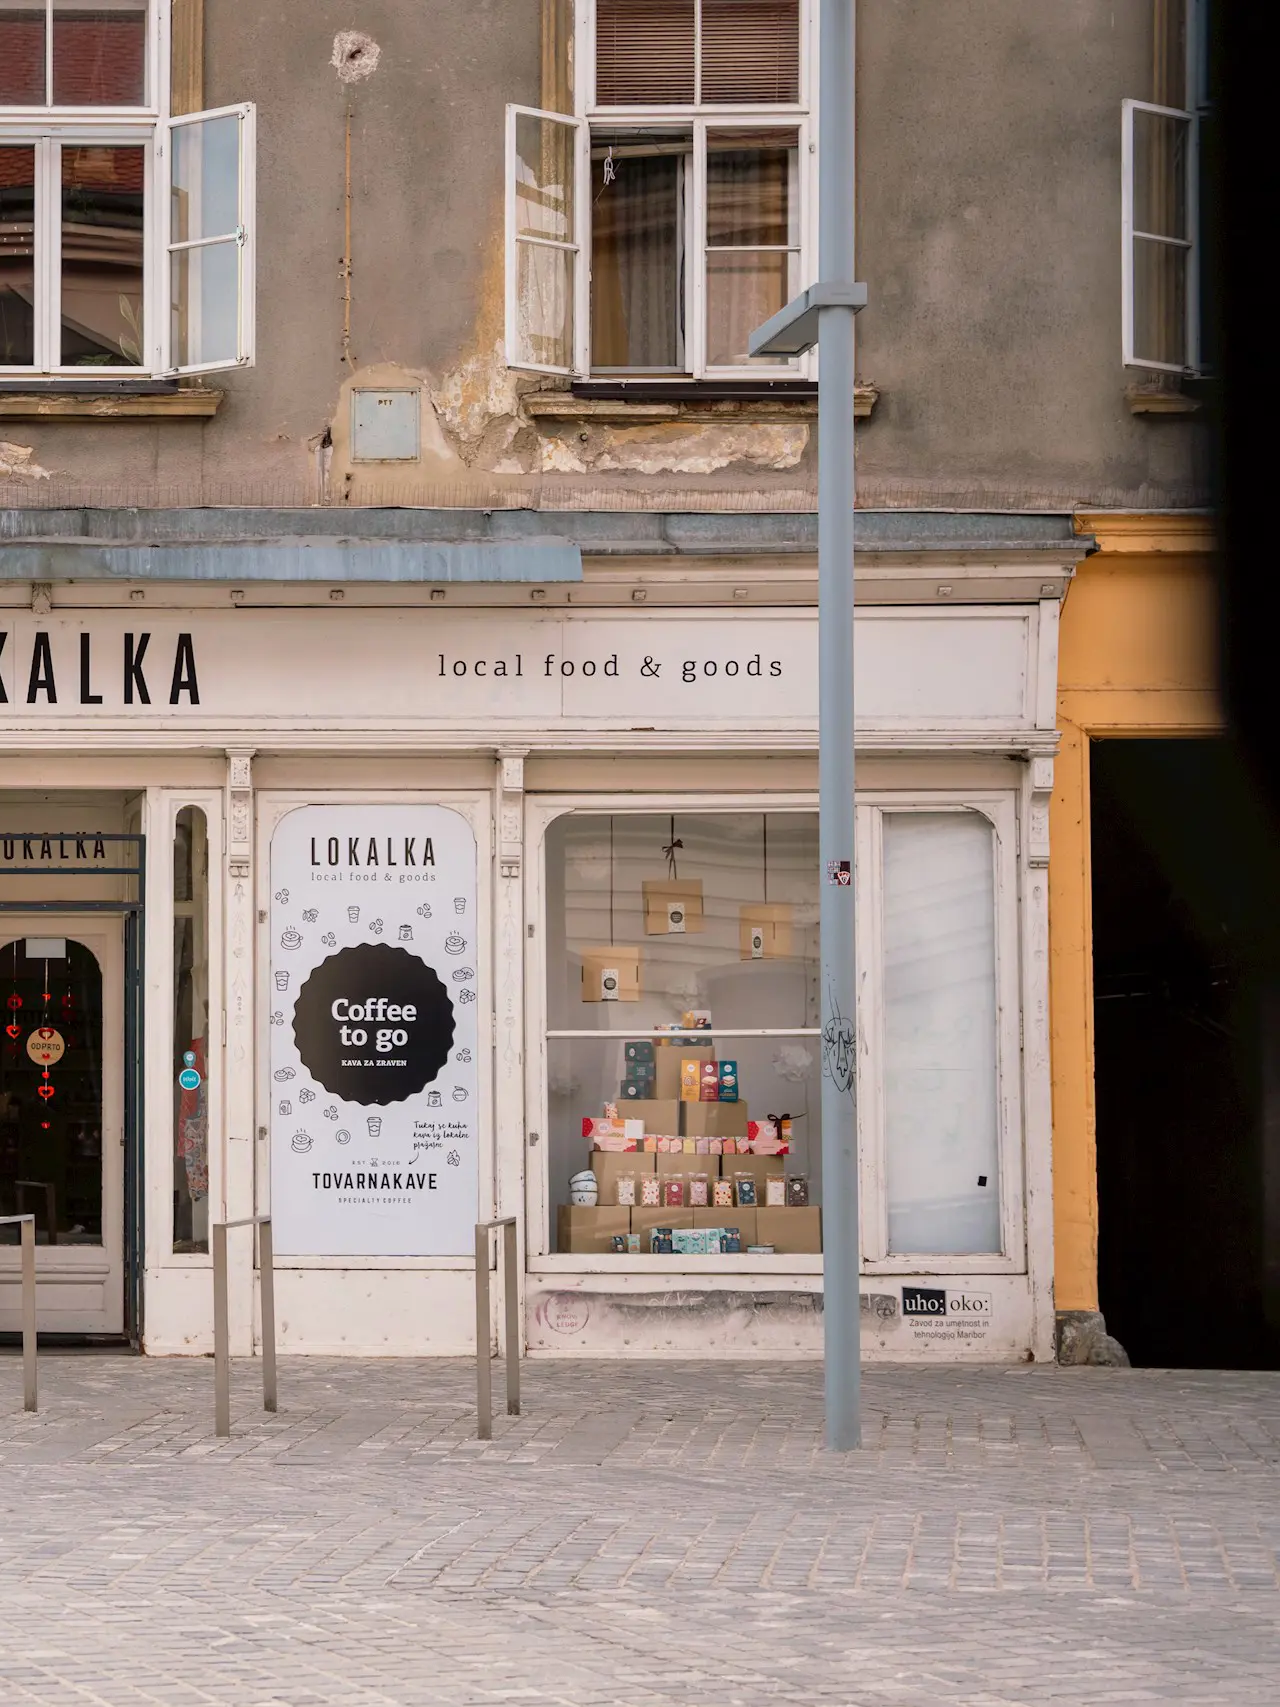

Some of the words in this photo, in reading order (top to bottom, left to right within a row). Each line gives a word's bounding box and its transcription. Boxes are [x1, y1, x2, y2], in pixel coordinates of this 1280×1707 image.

[438, 654, 524, 677] local
[544, 654, 620, 677] food
[639, 655, 662, 678] &
[681, 654, 783, 683] goods
[311, 836, 436, 866] LOKALKA
[311, 871, 342, 881] local
[349, 871, 377, 881] food
[383, 872, 392, 882] &
[399, 872, 436, 884] goods
[330, 997, 418, 1022] Coffee
[339, 1025, 368, 1047] to
[375, 1028, 409, 1053] go
[30, 1042, 61, 1051] ODPRTO
[341, 1059, 362, 1067] KAVA
[363, 1059, 375, 1067] ZA
[376, 1059, 407, 1067] ZRAVEN
[413, 1120, 435, 1133] Tukaj
[448, 1121, 468, 1130] kuha
[413, 1130, 430, 1139] kava
[432, 1132, 442, 1141] iz
[442, 1130, 470, 1139] lokalne
[312, 1172, 438, 1190] TOVARNAKAVE
[904, 1293, 945, 1314] uho;
[950, 1294, 989, 1312] oko:
[909, 1318, 933, 1327] Zavod
[945, 1319, 981, 1328] umetnost
[982, 1319, 990, 1328] in
[956, 1330, 986, 1339] Maribor
